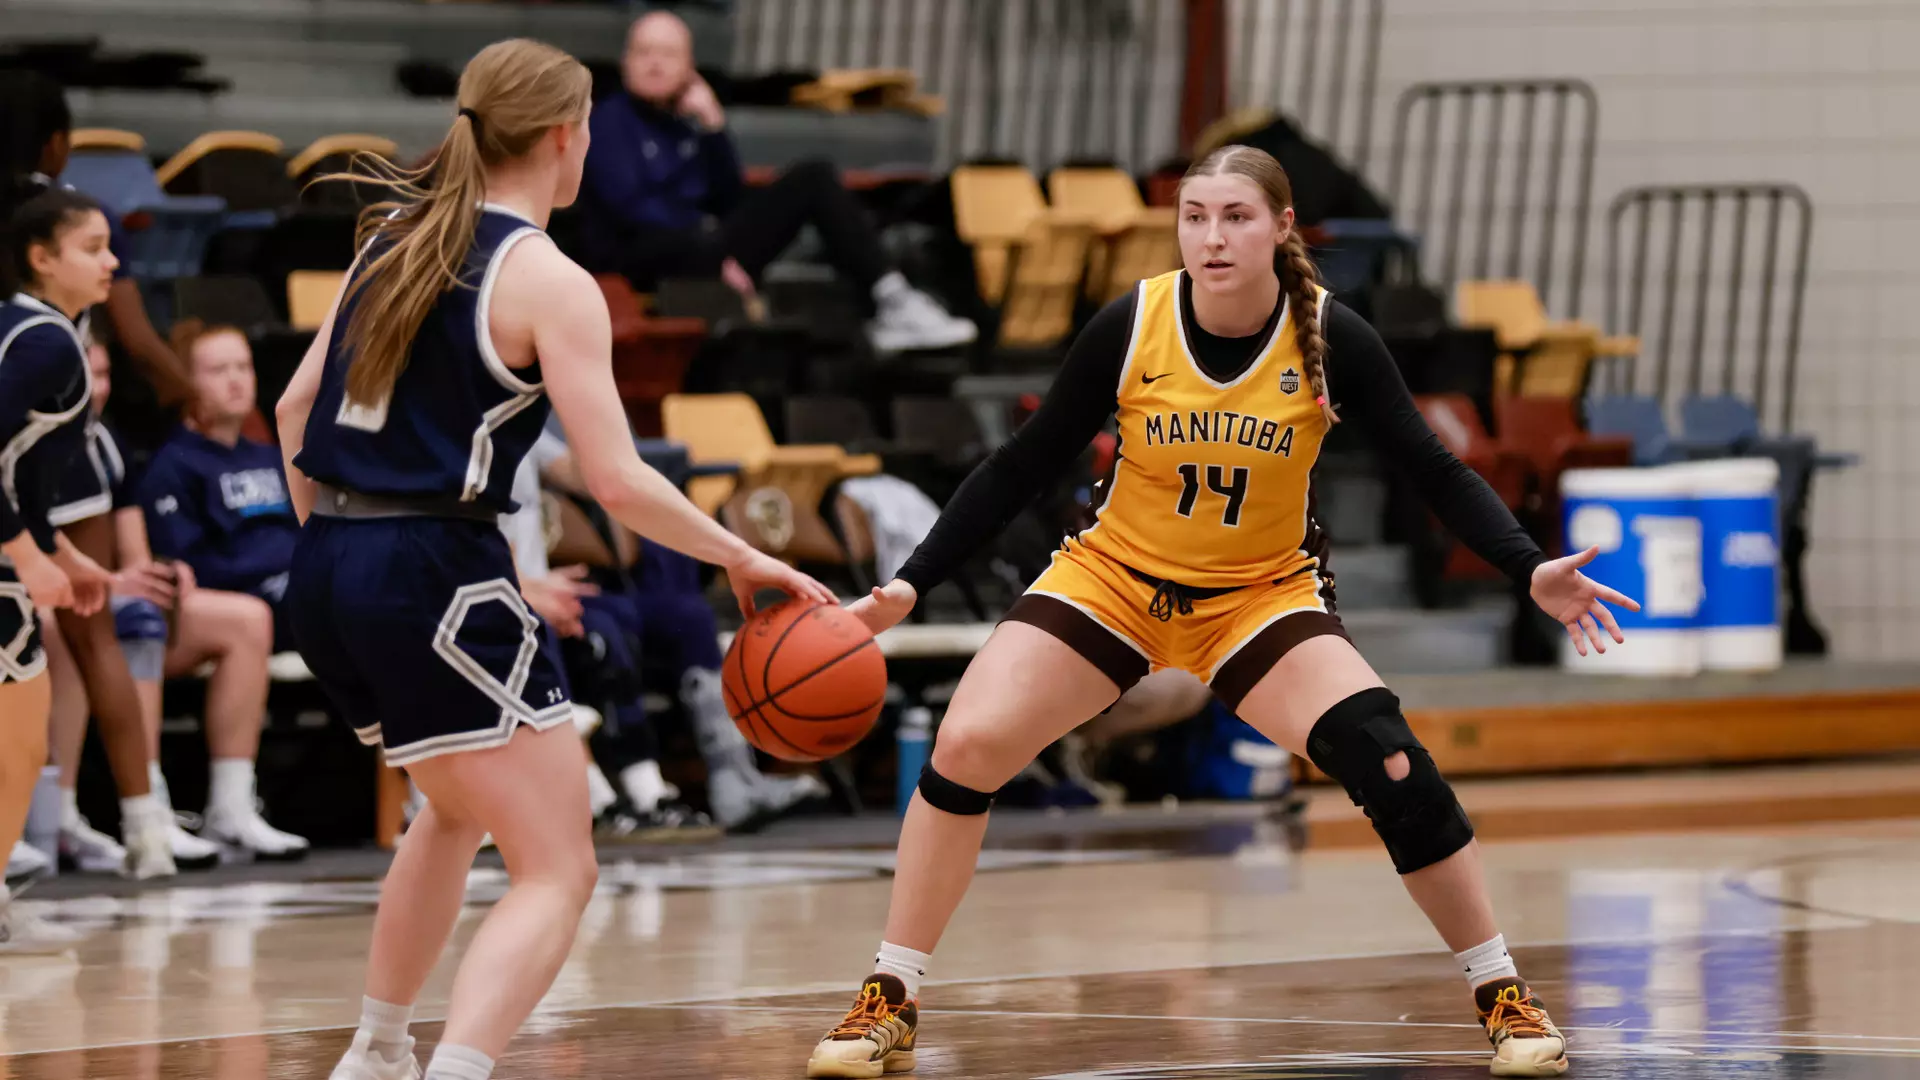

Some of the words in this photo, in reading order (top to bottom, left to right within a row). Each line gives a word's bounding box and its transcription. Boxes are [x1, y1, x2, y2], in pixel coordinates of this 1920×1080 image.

[1281, 383, 1298, 391] WEST
[1145, 410, 1295, 458] MANITOBA
[1175, 463, 1250, 528] 14
